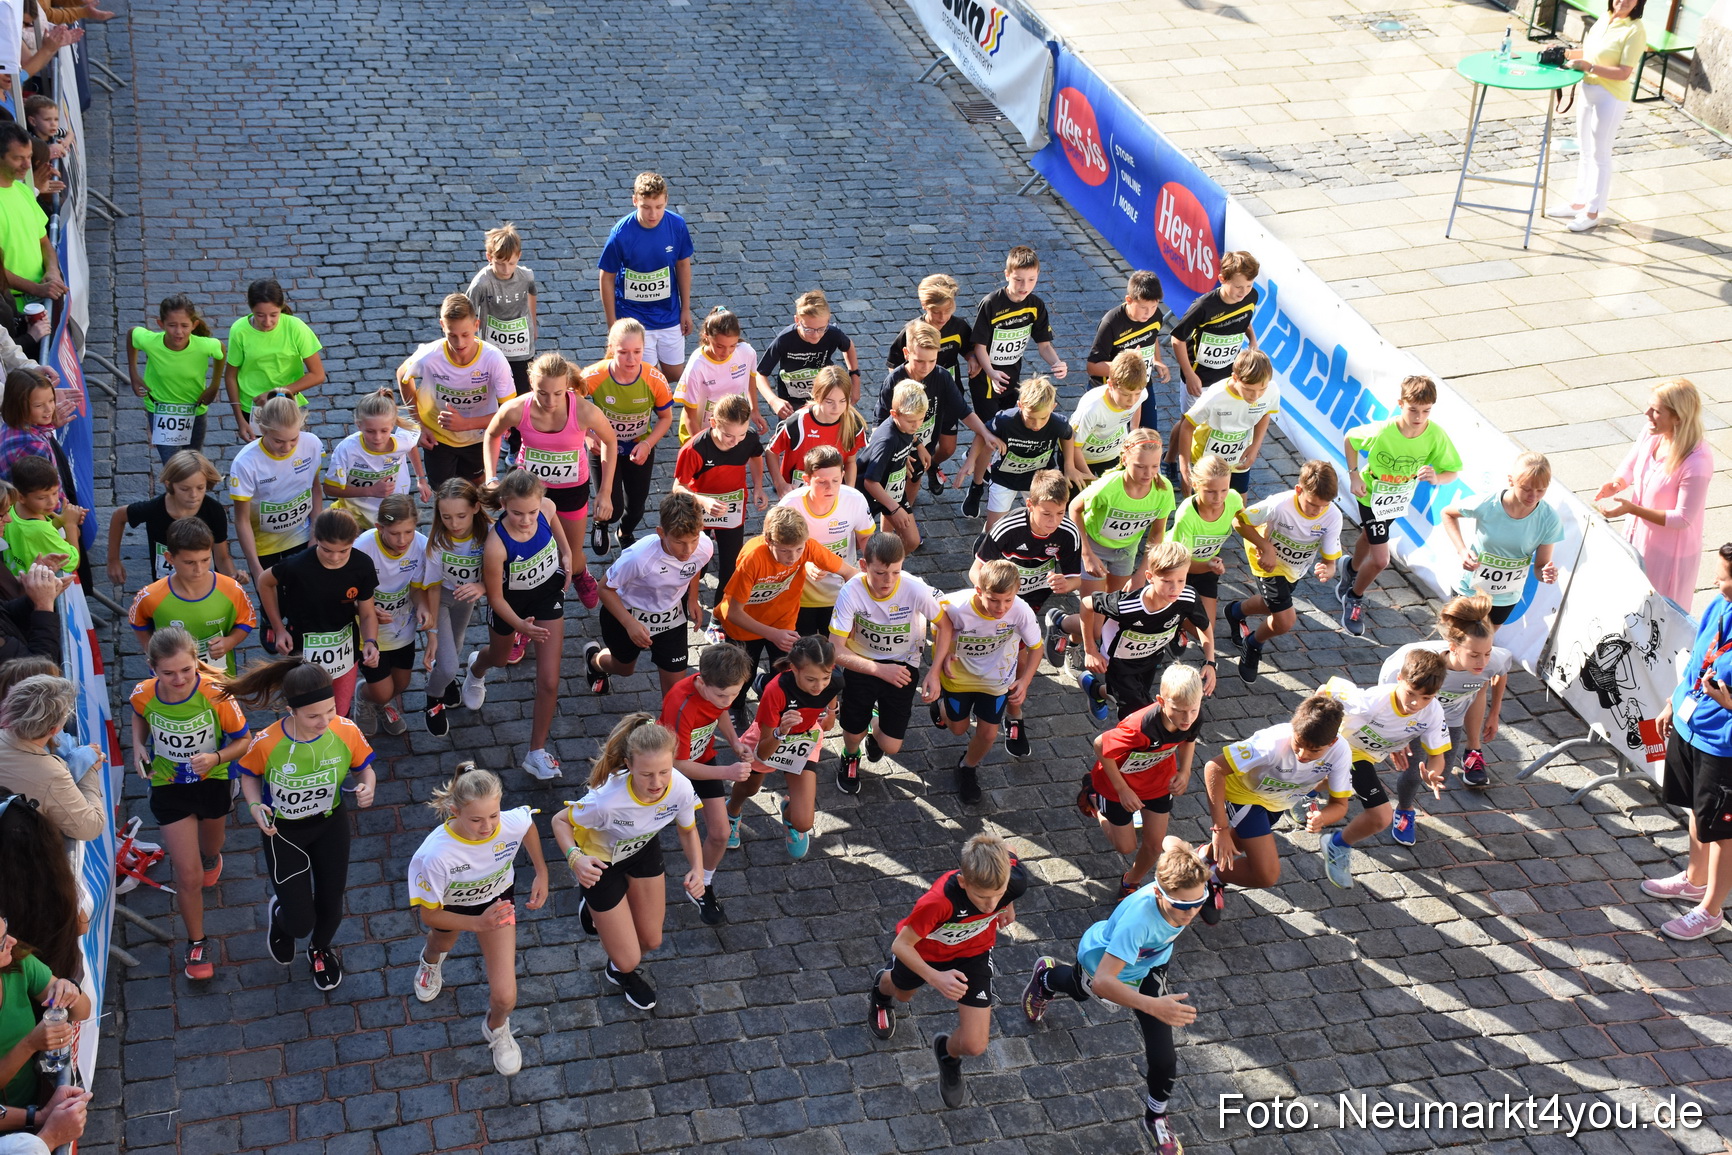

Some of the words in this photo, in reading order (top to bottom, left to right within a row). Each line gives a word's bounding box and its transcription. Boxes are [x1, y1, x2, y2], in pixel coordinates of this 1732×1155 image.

[1115, 144, 1135, 168] STORE
[1121, 169, 1141, 197] ONLINE
[1119, 195, 1138, 224] MOBILE
[1158, 188, 1214, 280] Hervis
[627, 270, 668, 282] BOCK
[629, 281, 665, 292] 4003
[490, 318, 526, 331] BOCK
[490, 330, 525, 344] 4056
[1206, 333, 1243, 344] BOCK
[996, 338, 1027, 353] 4035
[1203, 345, 1238, 357] 4036
[790, 380, 813, 389] 405
[440, 386, 484, 397] BOCK
[441, 394, 483, 405] 4049
[157, 404, 195, 416] BOCK
[157, 416, 191, 431] 4054
[1213, 431, 1248, 442] BOCK
[1086, 439, 1121, 454] 4053
[1211, 441, 1244, 454] 4024
[530, 451, 572, 462] BOCK
[355, 466, 396, 479] BOCK
[530, 465, 573, 477] 4047
[1379, 483, 1414, 494] BOCK
[266, 490, 308, 513] BOCK
[1375, 494, 1408, 507] 4026
[267, 503, 308, 524] 4039
[1112, 508, 1160, 520] BOCK
[1376, 506, 1404, 517] LEONHARD
[273, 517, 303, 531] MIRIAM
[1109, 519, 1150, 531] 4010
[1370, 524, 1386, 537] 13
[515, 539, 556, 572] BOCK
[1193, 545, 1220, 554] 401
[1273, 542, 1312, 559] 4006
[446, 554, 481, 566] BOC
[1482, 556, 1531, 568] BOCK
[448, 567, 479, 579] 401
[516, 555, 554, 582] 4013
[1479, 567, 1524, 583] 4012
[529, 574, 545, 586] LISA
[1020, 573, 1048, 586] 002
[1491, 584, 1507, 592] EVA
[638, 607, 679, 624] 4022
[858, 618, 906, 633] BOCK
[309, 627, 351, 645] BOCK
[861, 630, 904, 644] 4016
[311, 643, 351, 665] 4014
[869, 643, 892, 652] LEON
[672, 655, 686, 663] JAKO
[154, 714, 211, 732] BOCK
[158, 730, 207, 749] 4027
[767, 754, 794, 766] NOEMI
[275, 771, 331, 788] BOCK
[276, 788, 328, 806] 4029
[280, 803, 319, 815] CAROLA
[452, 876, 503, 897] 4007
[454, 892, 493, 903] CECILIA
